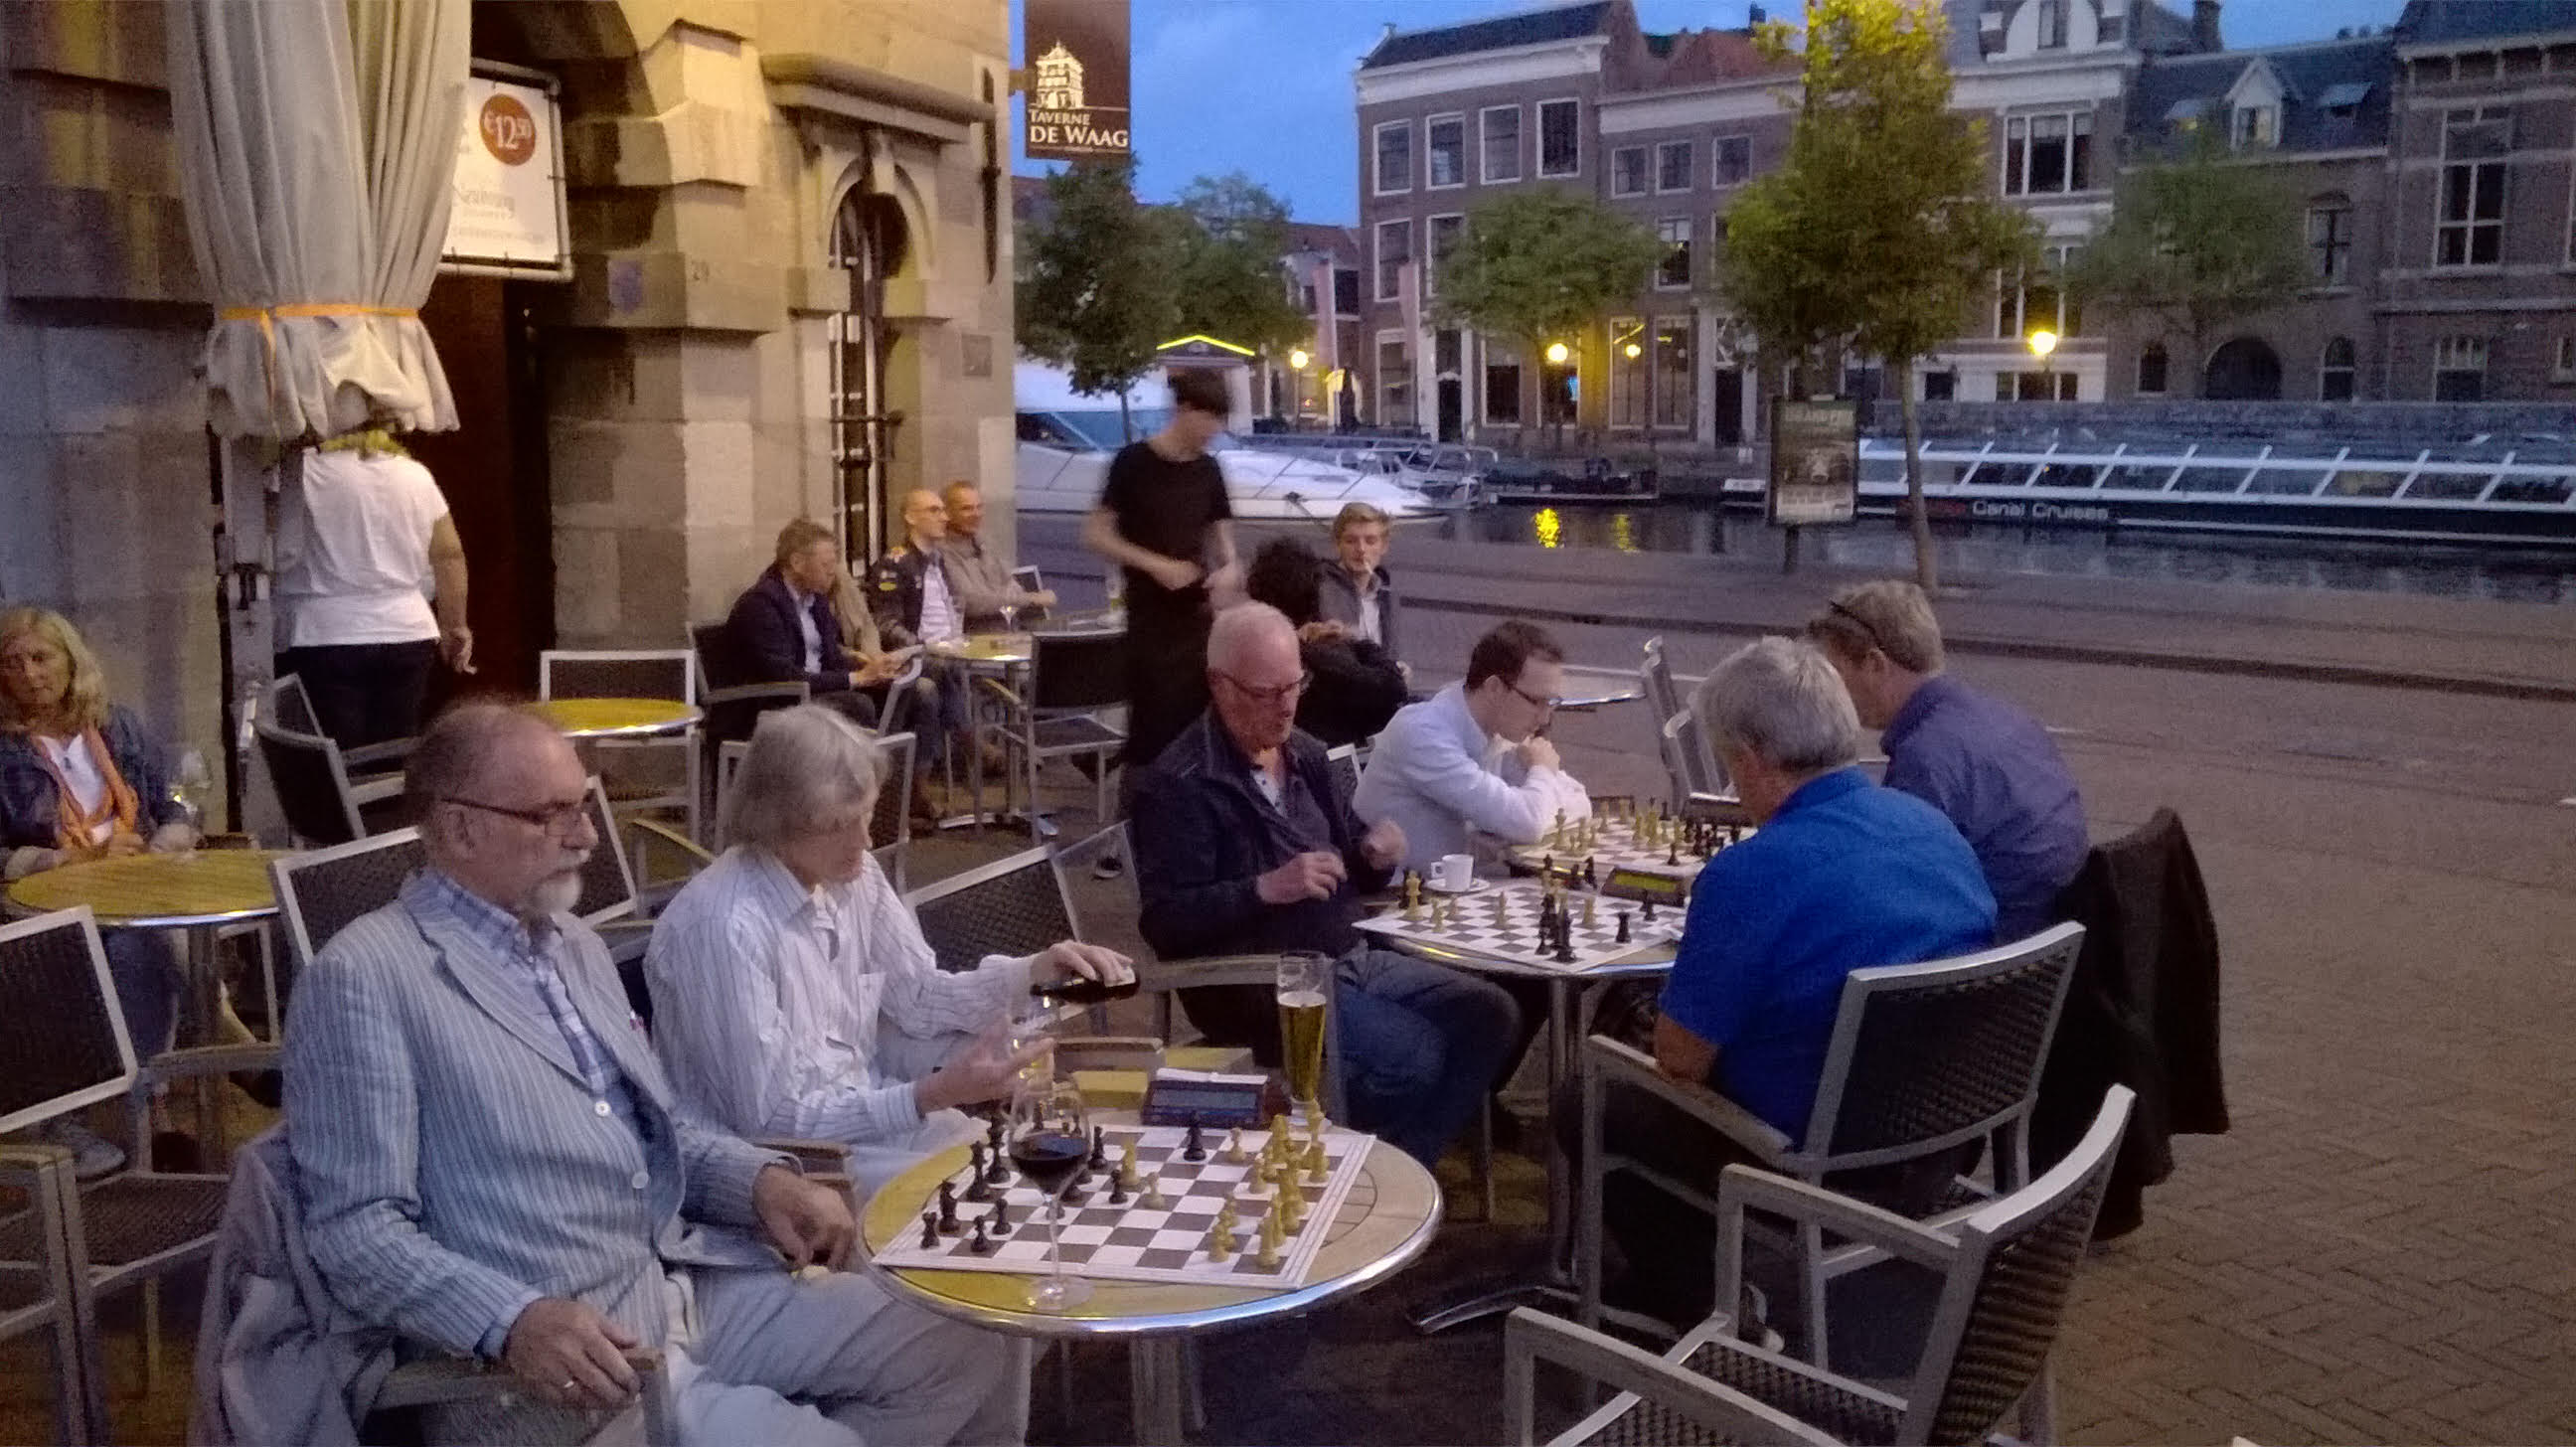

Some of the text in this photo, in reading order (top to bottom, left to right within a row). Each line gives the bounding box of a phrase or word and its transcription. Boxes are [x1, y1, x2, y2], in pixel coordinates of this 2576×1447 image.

[1029, 108, 1091, 125] TAVERNE
[1030, 125, 1129, 148] DE WAAG
[1973, 500, 2025, 517] Canal
[2032, 502, 2109, 521] Cruises
